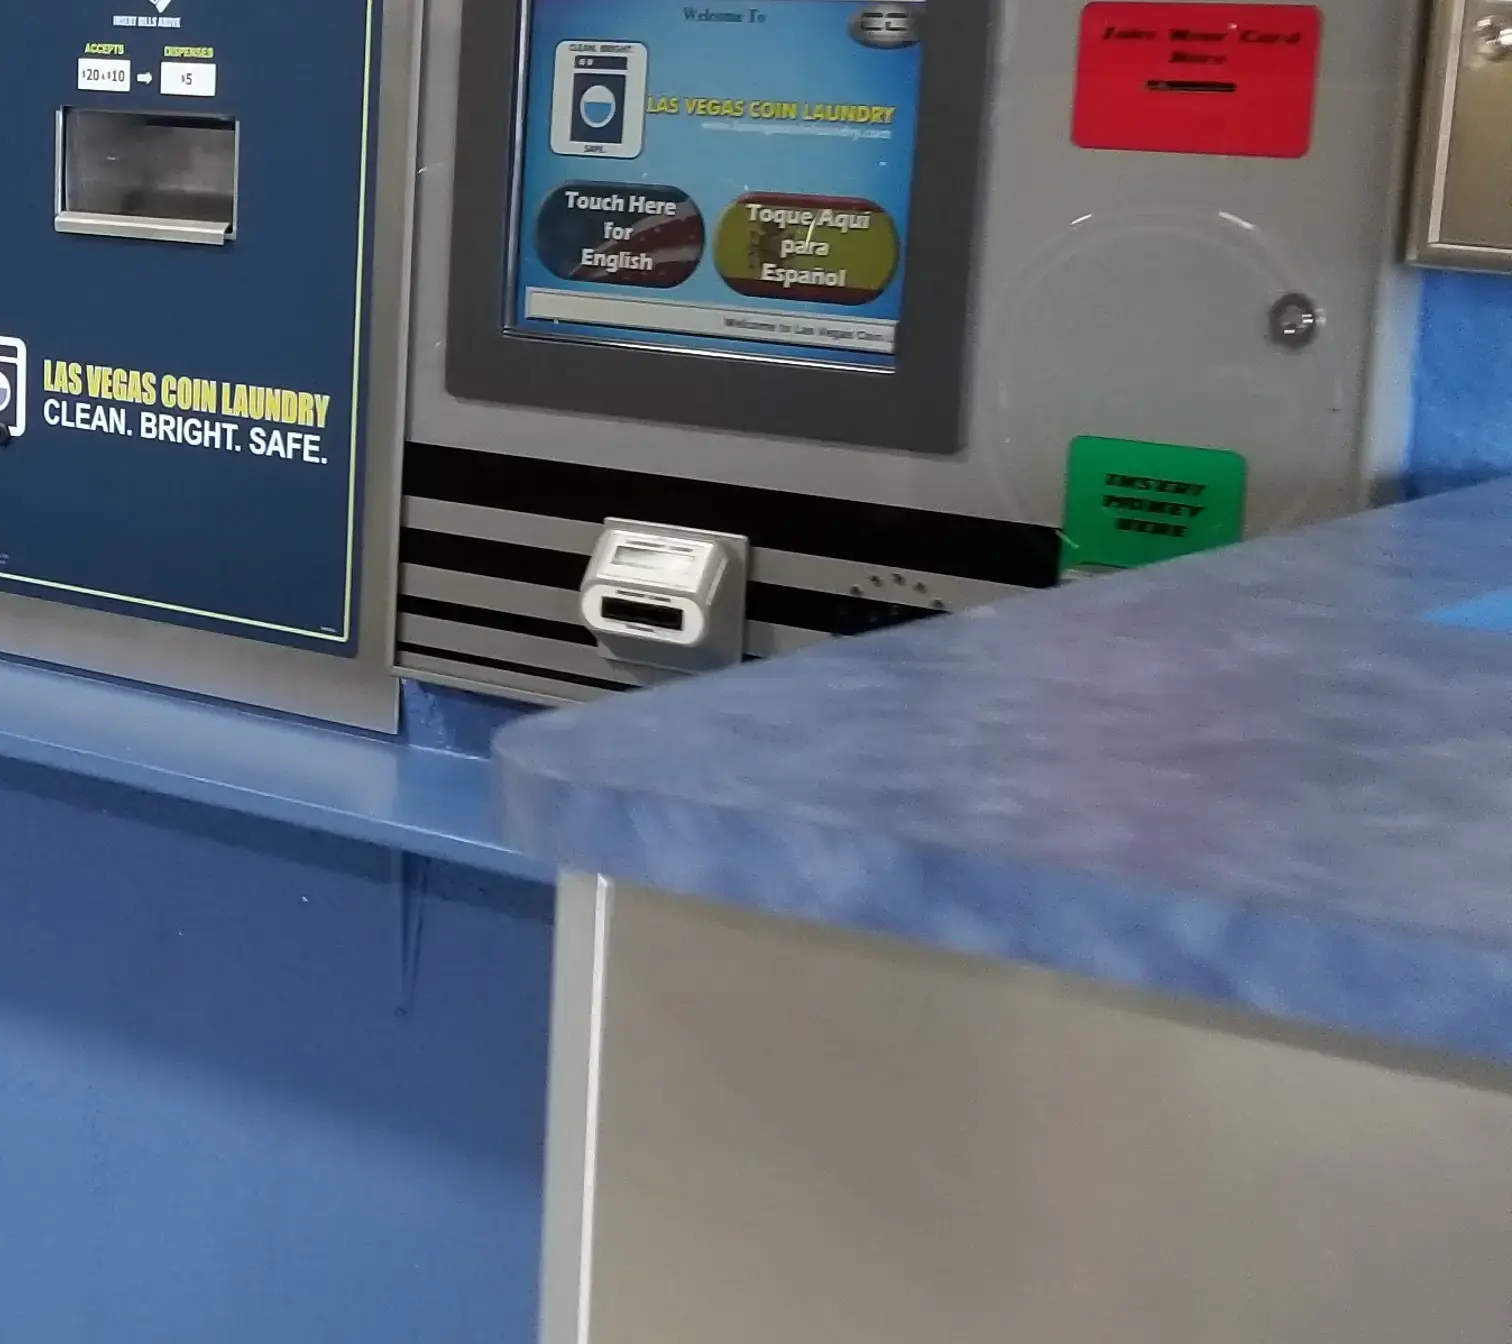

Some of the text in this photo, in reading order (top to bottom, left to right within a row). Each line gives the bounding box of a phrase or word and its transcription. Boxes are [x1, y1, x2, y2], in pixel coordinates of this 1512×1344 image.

[84, 43, 125, 55] ACCEPTS
[646, 94, 896, 125] LAS VEGAS COIN LAUNDRY
[565, 191, 677, 217] Touch Here
[746, 204, 813, 229] Toque
[603, 221, 634, 242] for
[780, 238, 830, 259] para
[580, 249, 653, 274] English
[43, 359, 331, 429] LAS VEGAS COIN LAUNDRY
[43, 399, 328, 465] CLEAN. BRIGHT. SAFE.
